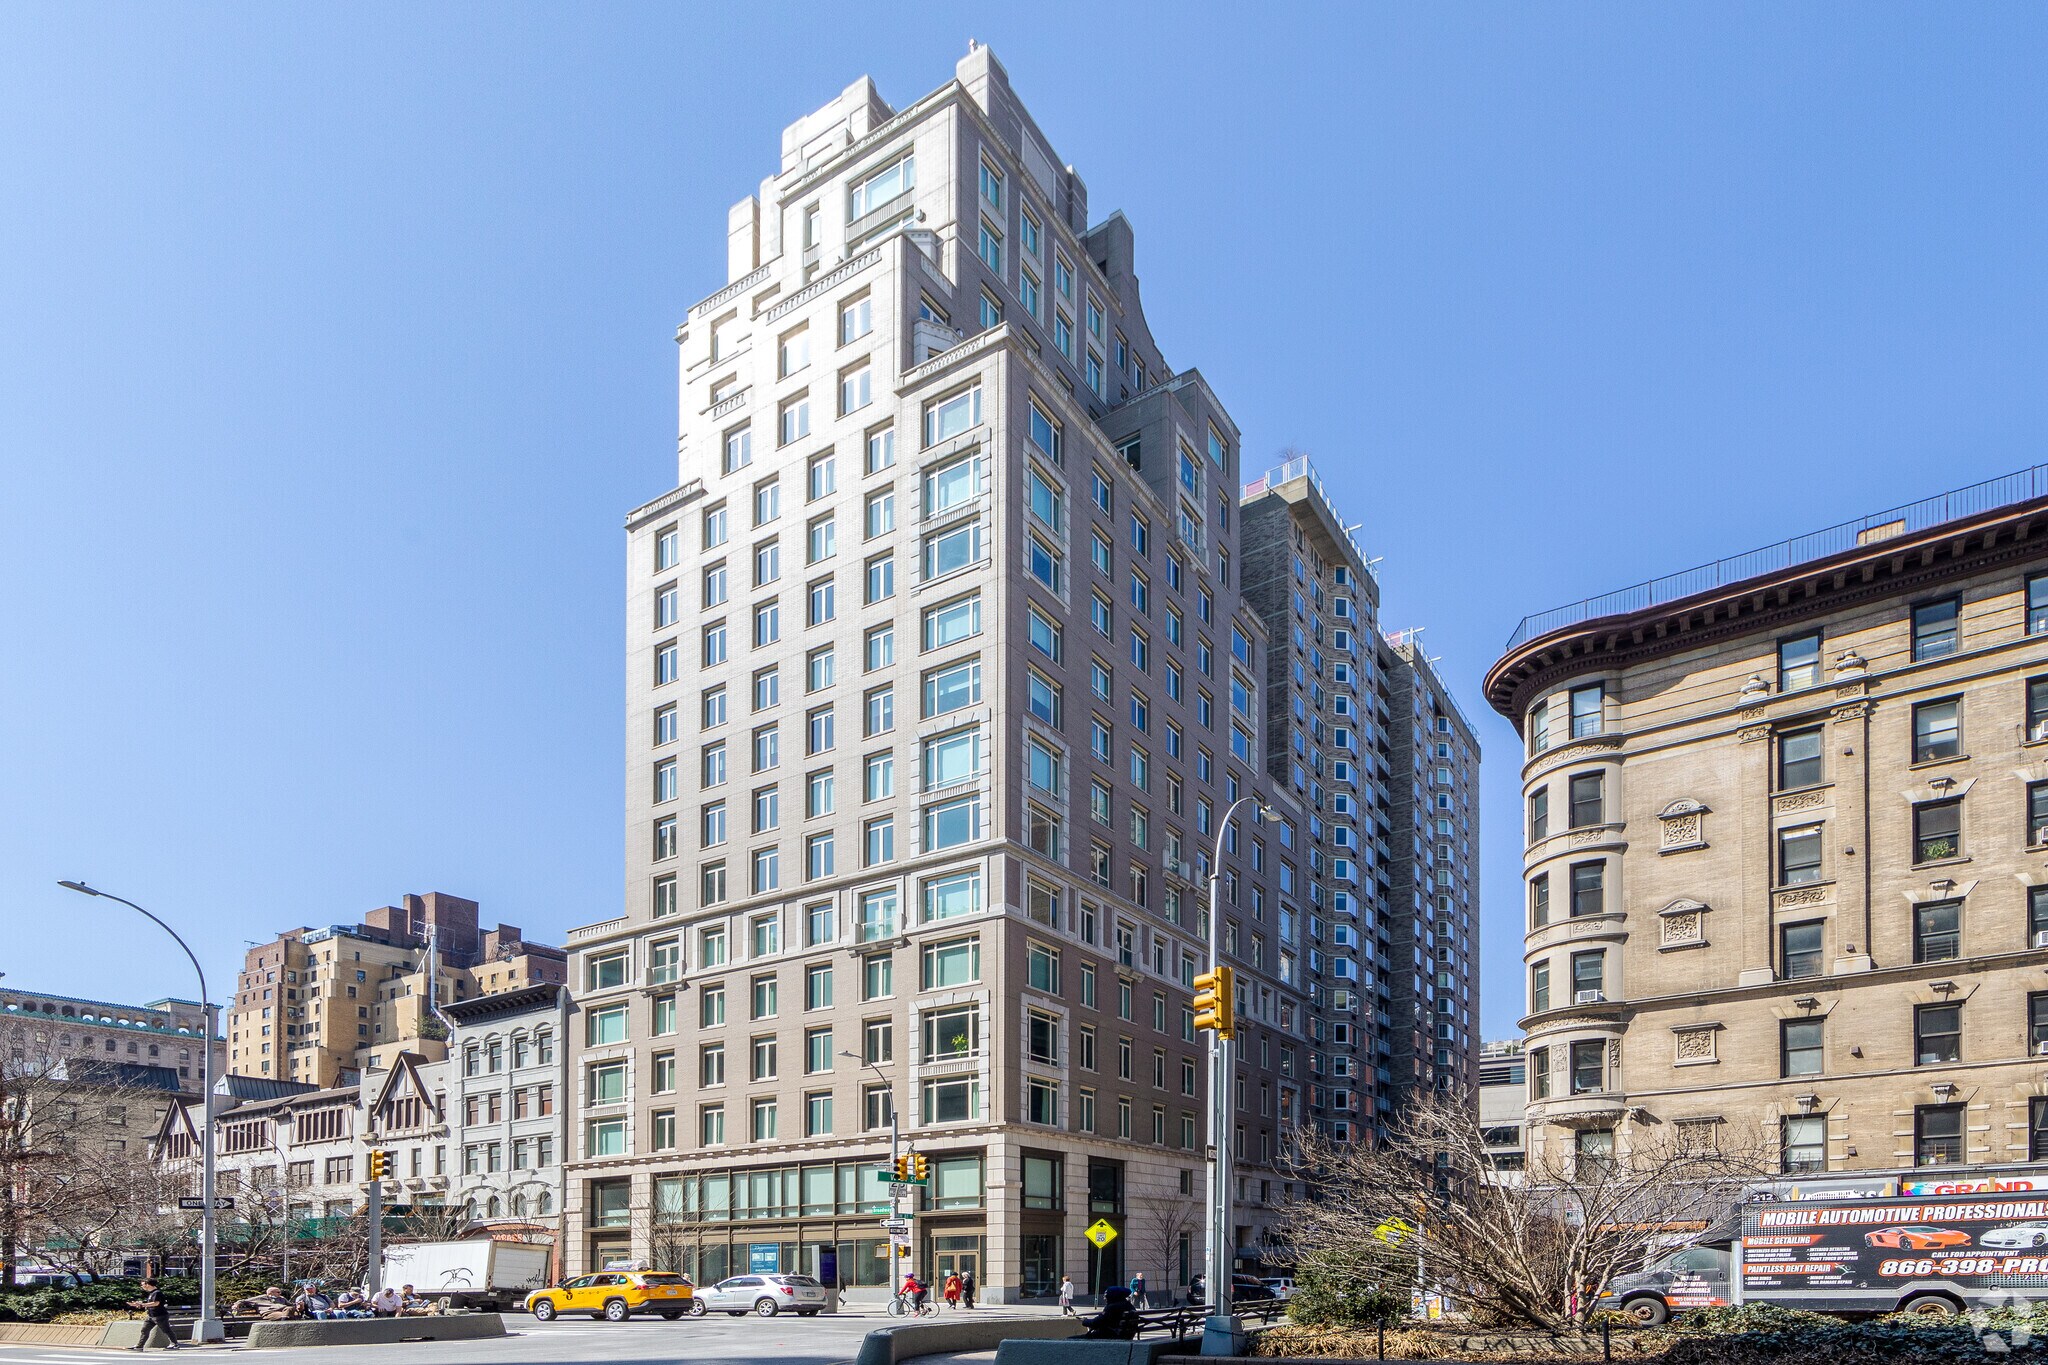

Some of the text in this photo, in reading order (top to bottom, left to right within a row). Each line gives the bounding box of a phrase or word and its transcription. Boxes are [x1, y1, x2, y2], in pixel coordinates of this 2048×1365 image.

[1935, 1181, 2034, 1195] GRAND
[1761, 1211, 1818, 1226] MOBILE
[1818, 1207, 1921, 1225] AUTOMOTIVE
[1747, 1236, 1811, 1245] MOBILE DETAILING
[1931, 1251, 1950, 1259] CALL
[1966, 1250, 2020, 1258] APPOINTMENT
[1747, 1263, 1831, 1273] PAINTLESS DENT REPAIR
